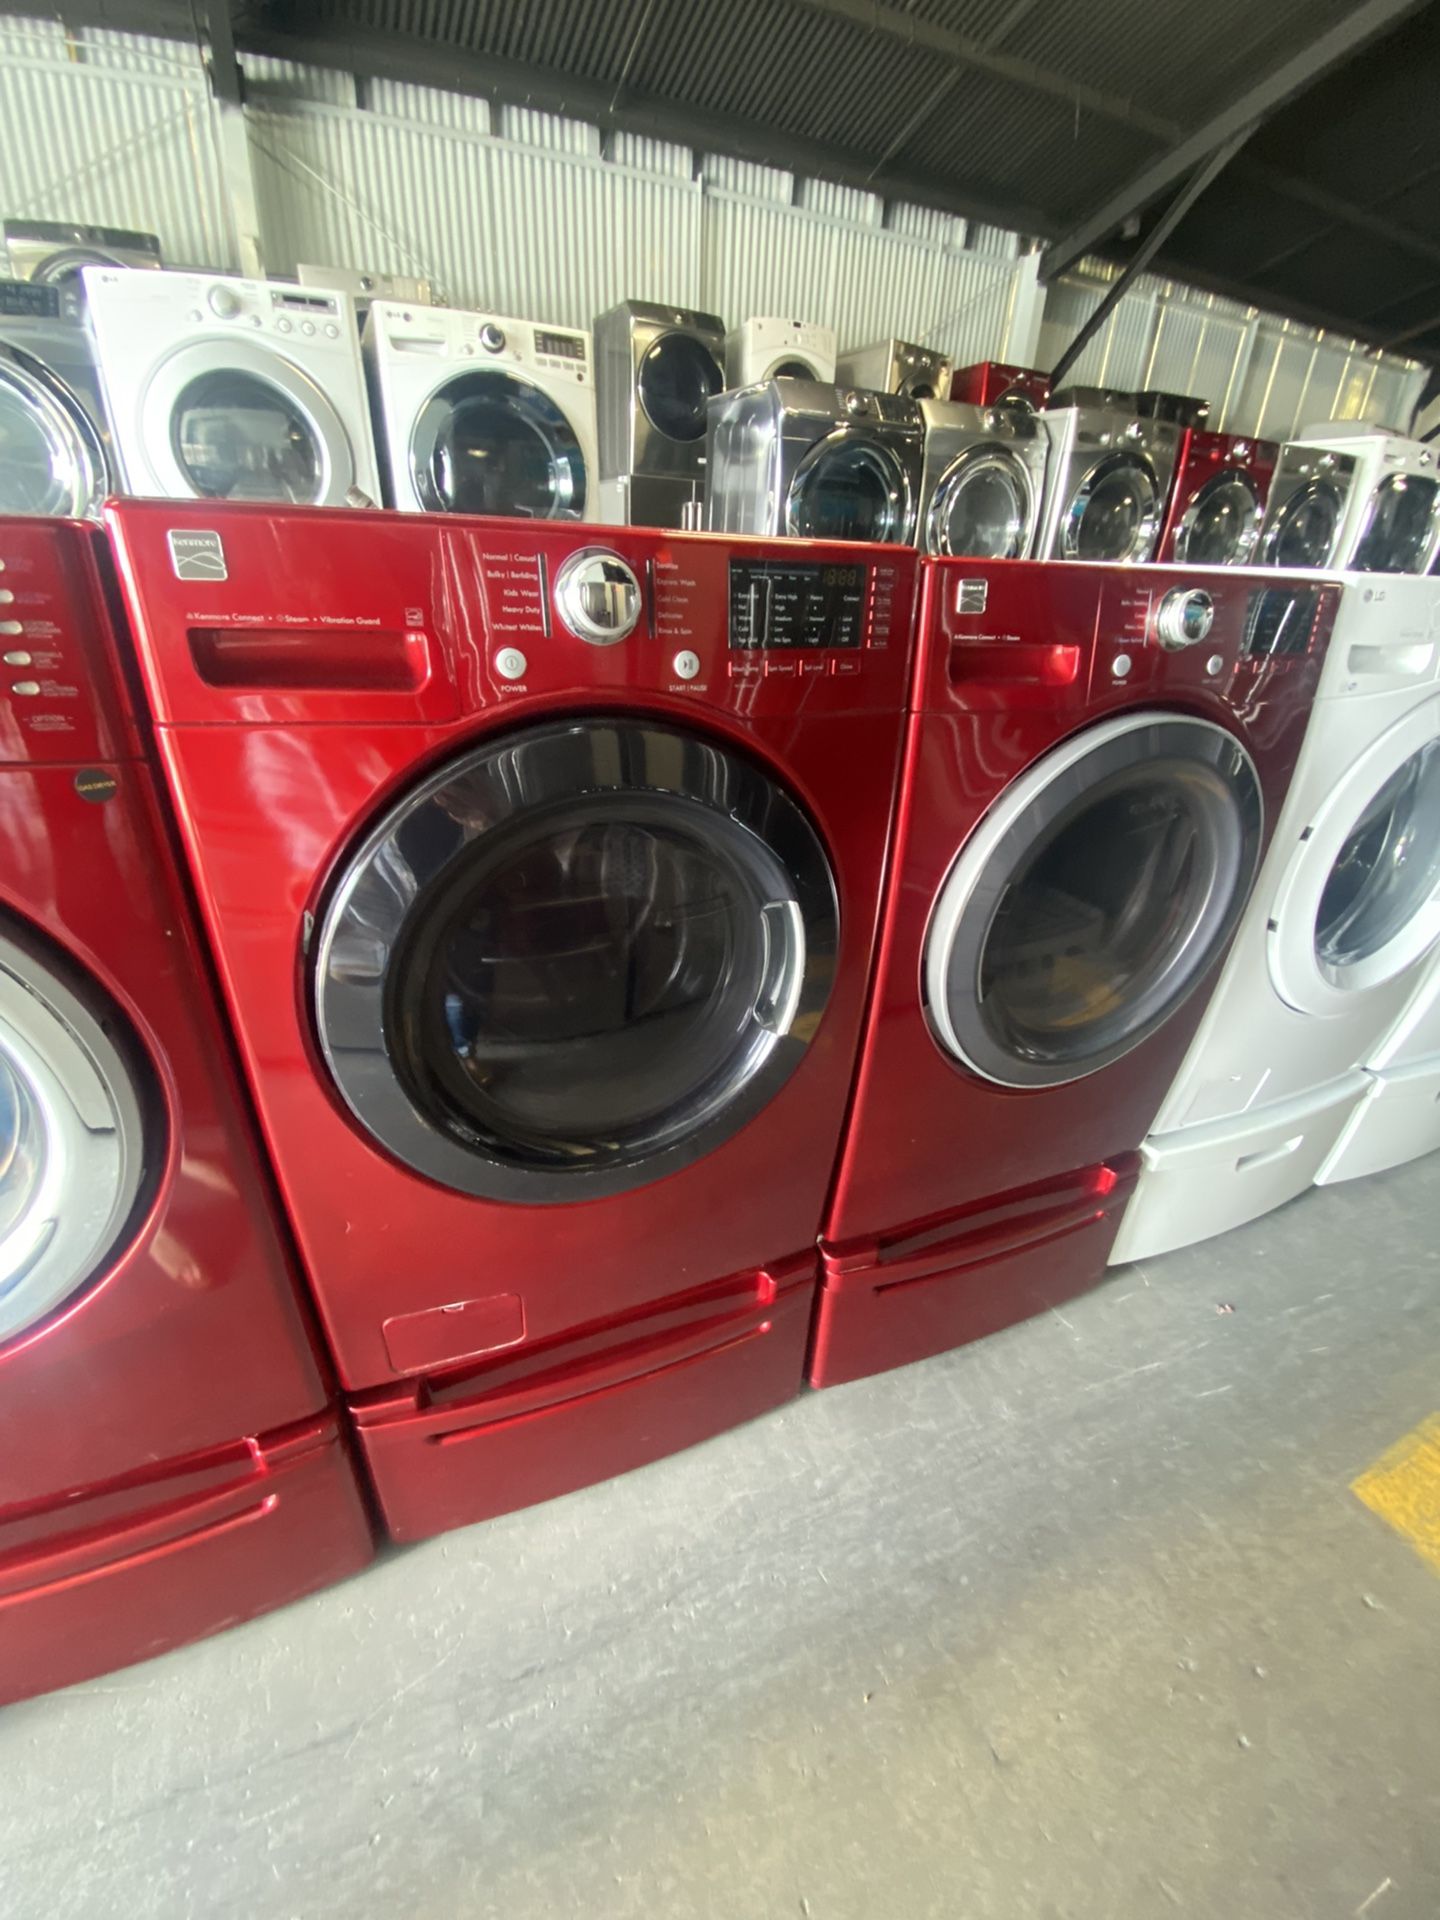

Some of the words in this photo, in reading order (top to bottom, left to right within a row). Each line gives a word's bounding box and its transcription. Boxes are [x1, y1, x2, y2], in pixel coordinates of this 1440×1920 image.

[483, 552, 508, 561] Normal
[513, 553, 537, 562] Casual
[487, 570, 505, 579] Bulky
[503, 588, 519, 597] Kids
[520, 588, 539, 597] Wear
[502, 604, 523, 614] Heavy
[525, 605, 541, 615] Duty
[193, 611, 230, 621] Kenmore
[231, 612, 265, 622] Connect
[285, 614, 310, 623] Steam
[320, 615, 355, 625] Vibration
[355, 616, 381, 626] Guard
[519, 623, 543, 632] Whites
[501, 685, 528, 693] POWER
[669, 684, 687, 692] START
